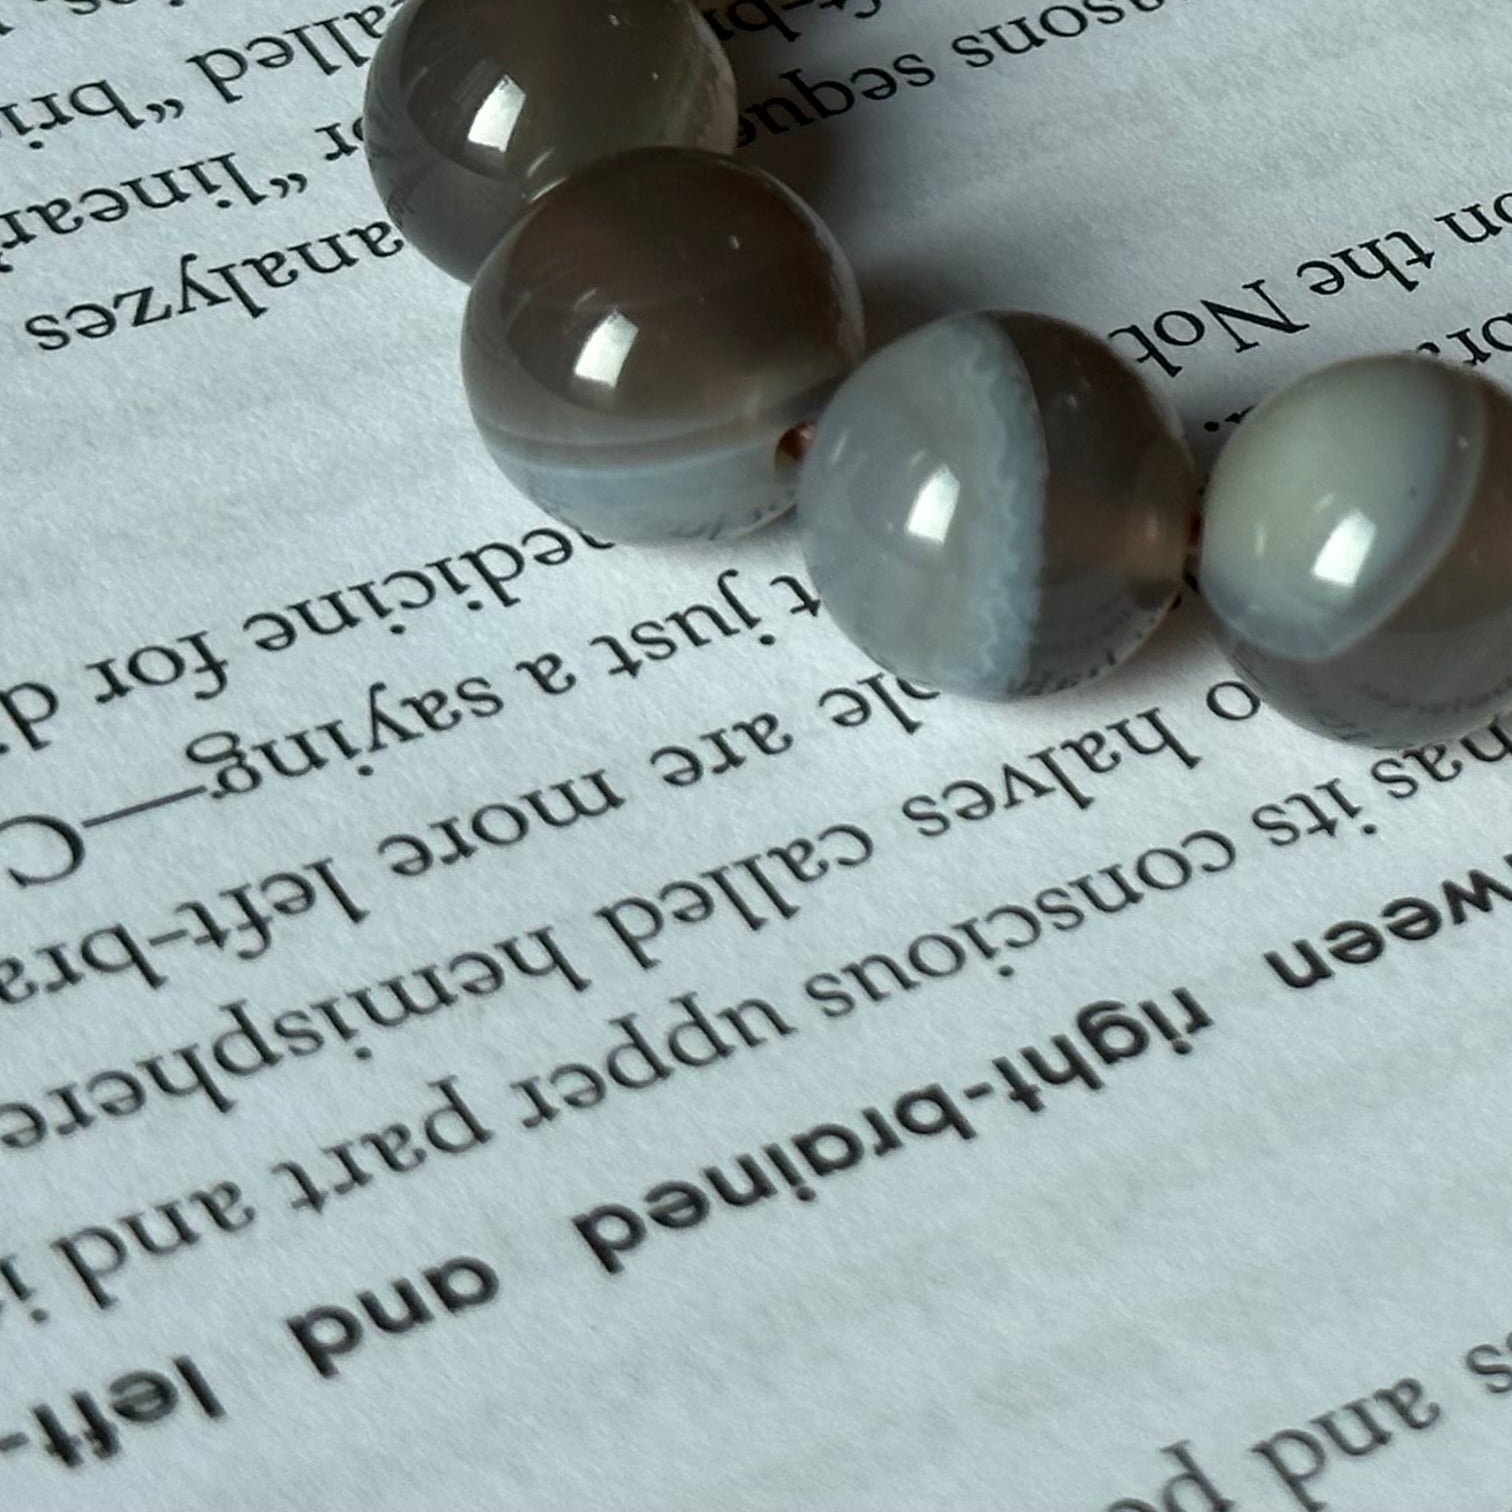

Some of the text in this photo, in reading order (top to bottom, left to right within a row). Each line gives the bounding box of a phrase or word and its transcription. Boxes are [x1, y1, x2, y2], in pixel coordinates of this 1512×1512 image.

[186, 0, 405, 104] alled
[24, 219, 405, 352] analyzes
[1295, 231, 1435, 297] the
[84, 525, 616, 702] edicine for
[514, 651, 578, 698] a
[588, 569, 777, 679] just
[647, 709, 795, 790] are
[898, 706, 1199, 839] halves
[1250, 776, 1380, 848] its
[374, 767, 626, 881] more
[593, 822, 875, 971] called
[800, 828, 1236, 1020] conscious
[507, 991, 797, 1130] upper
[269, 1075, 494, 1215] part
[570, 987, 1213, 1275] right-brained
[48, 1181, 257, 1311] and
[285, 1256, 500, 1380] and
[0, 1355, 227, 1470] left-
[1250, 1377, 1441, 1512] and
